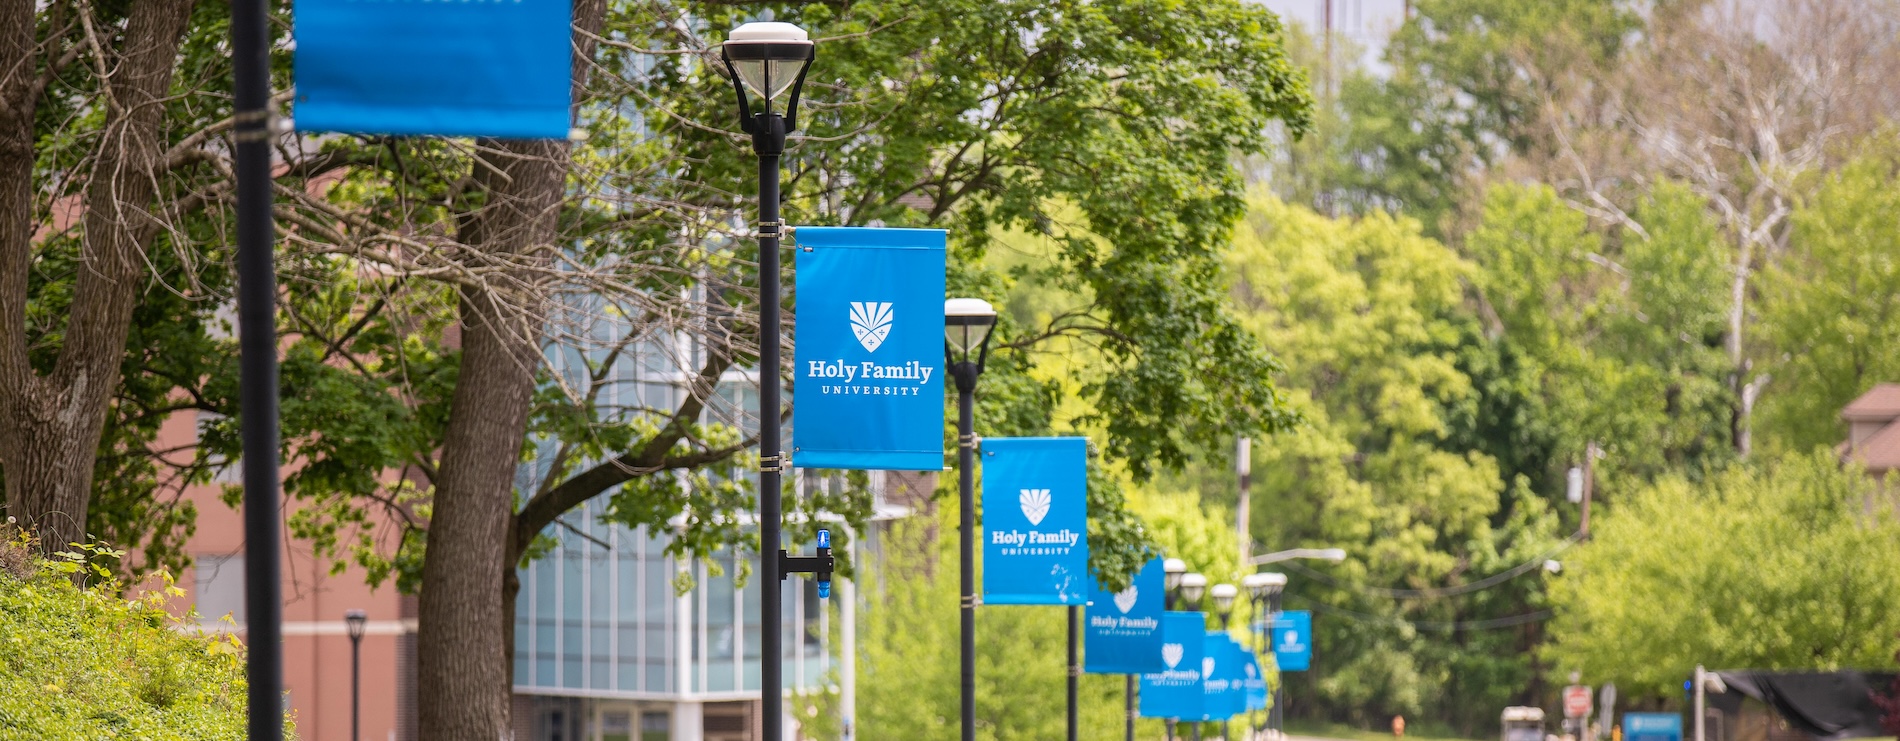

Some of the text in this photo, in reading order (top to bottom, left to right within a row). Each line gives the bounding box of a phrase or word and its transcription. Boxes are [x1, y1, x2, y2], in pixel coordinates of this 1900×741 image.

[808, 359, 933, 384] Holy Family
[822, 385, 919, 396] UNIVERSITY
[992, 529, 1079, 547] Holy Family
[1001, 547, 1070, 556] UNIVERSITY
[1119, 616, 1158, 631] Family
